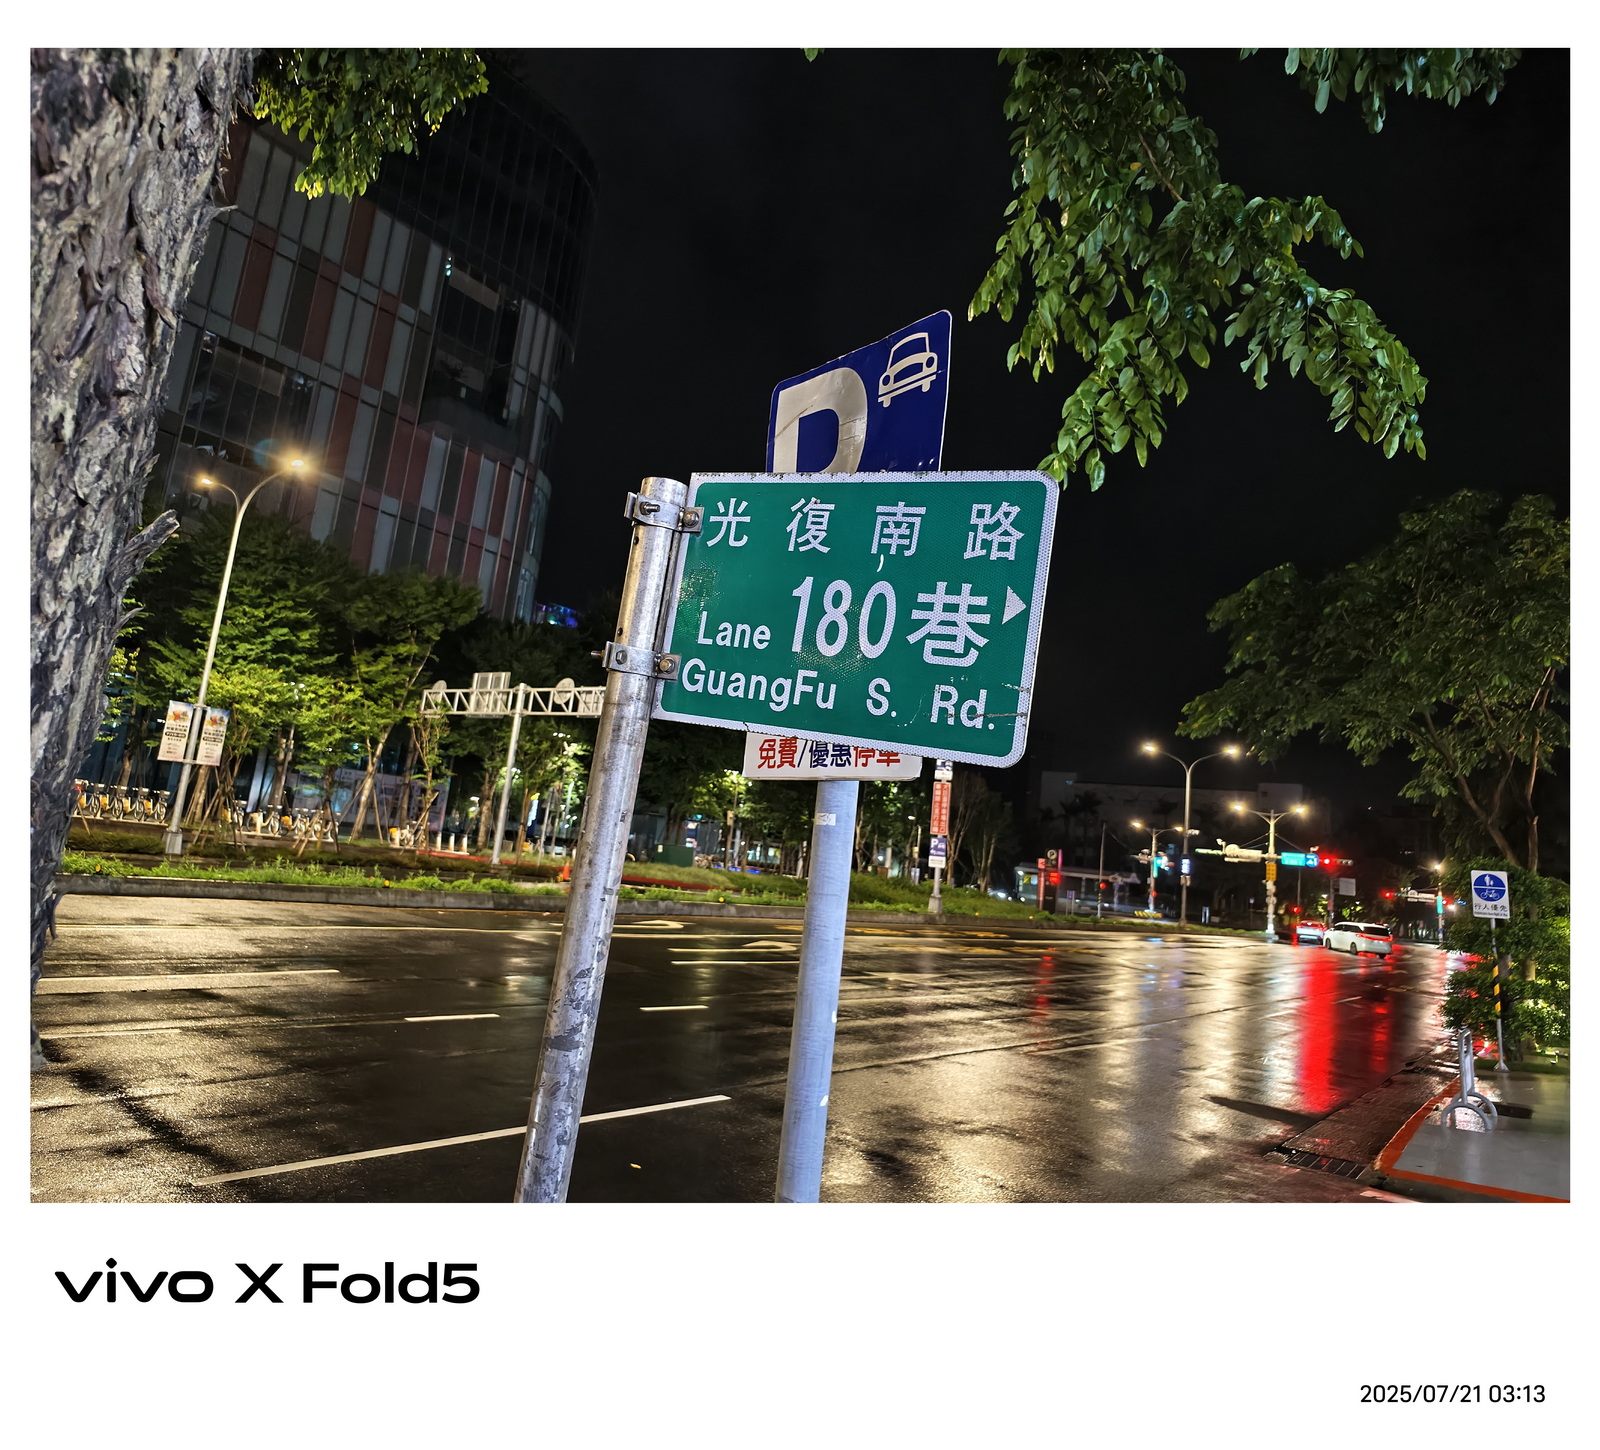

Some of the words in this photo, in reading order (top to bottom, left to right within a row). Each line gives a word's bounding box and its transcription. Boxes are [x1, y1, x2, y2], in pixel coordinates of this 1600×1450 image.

[706, 497, 1025, 561] 光復南路
[697, 610, 771, 650] Lane
[681, 657, 837, 712] GuangFu
[866, 677, 897, 718] S.
[930, 684, 995, 730] Rd.
[1474, 903, 1508, 912] 行人優先
